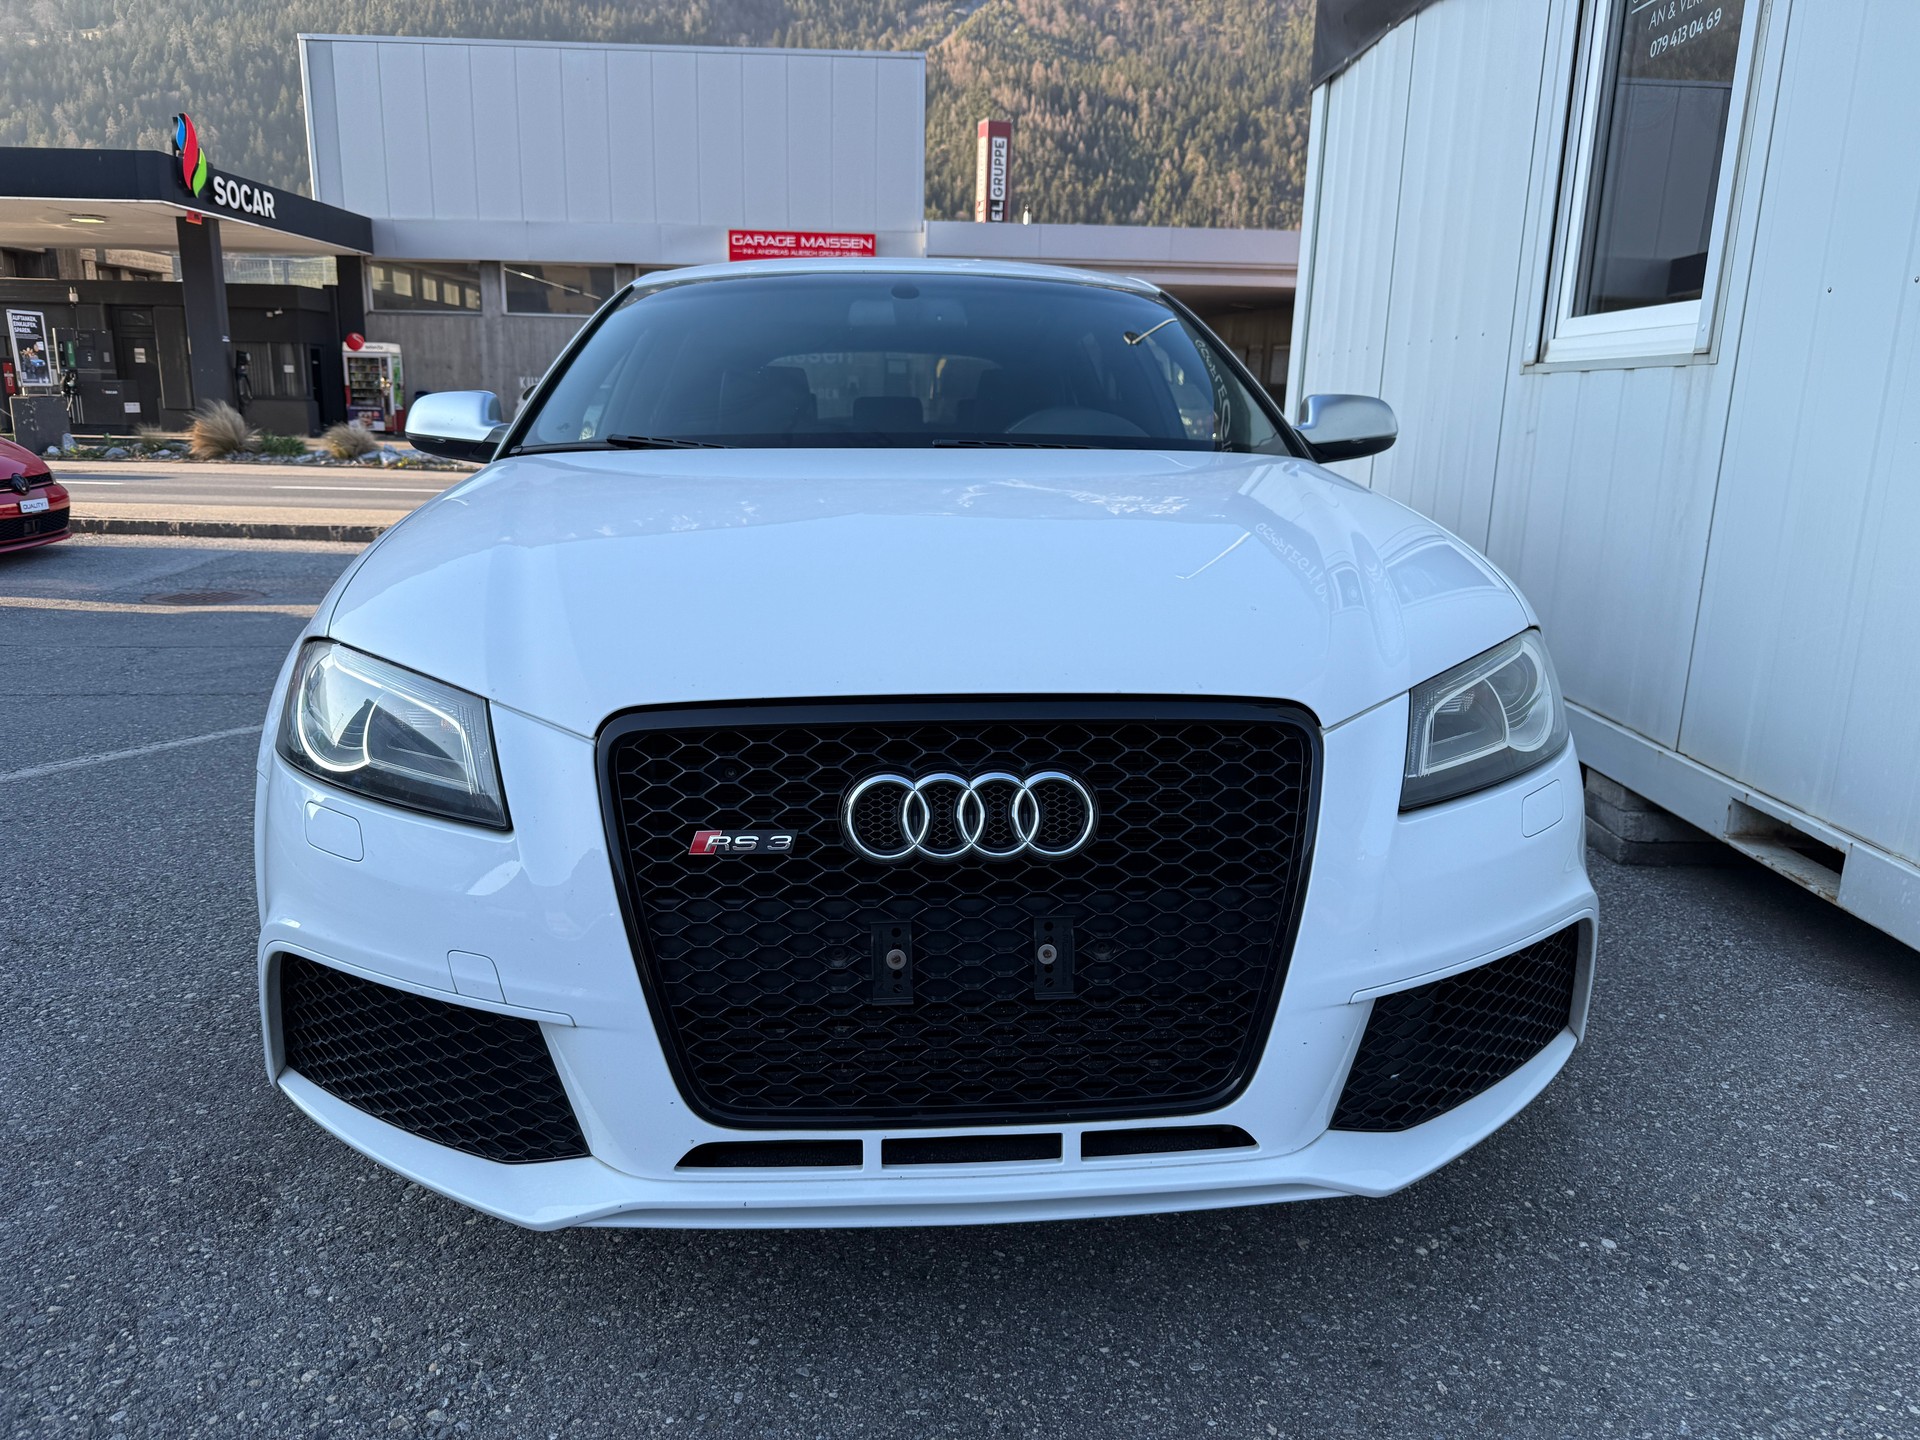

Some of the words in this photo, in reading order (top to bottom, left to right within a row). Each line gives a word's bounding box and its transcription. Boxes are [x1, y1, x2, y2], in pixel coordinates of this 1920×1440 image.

[1648, 5, 1666, 30] AN
[1650, 34, 1669, 58] 079
[1670, 25, 1688, 47] 413
[1689, 16, 1704, 38] 04
[1706, 7, 1722, 31] 69
[992, 140, 1005, 198] GRUPPE
[213, 175, 276, 219] SOCAR
[731, 234, 796, 247] GARAGE
[801, 236, 873, 250] MAISSEN
[766, 835, 793, 851] 3
